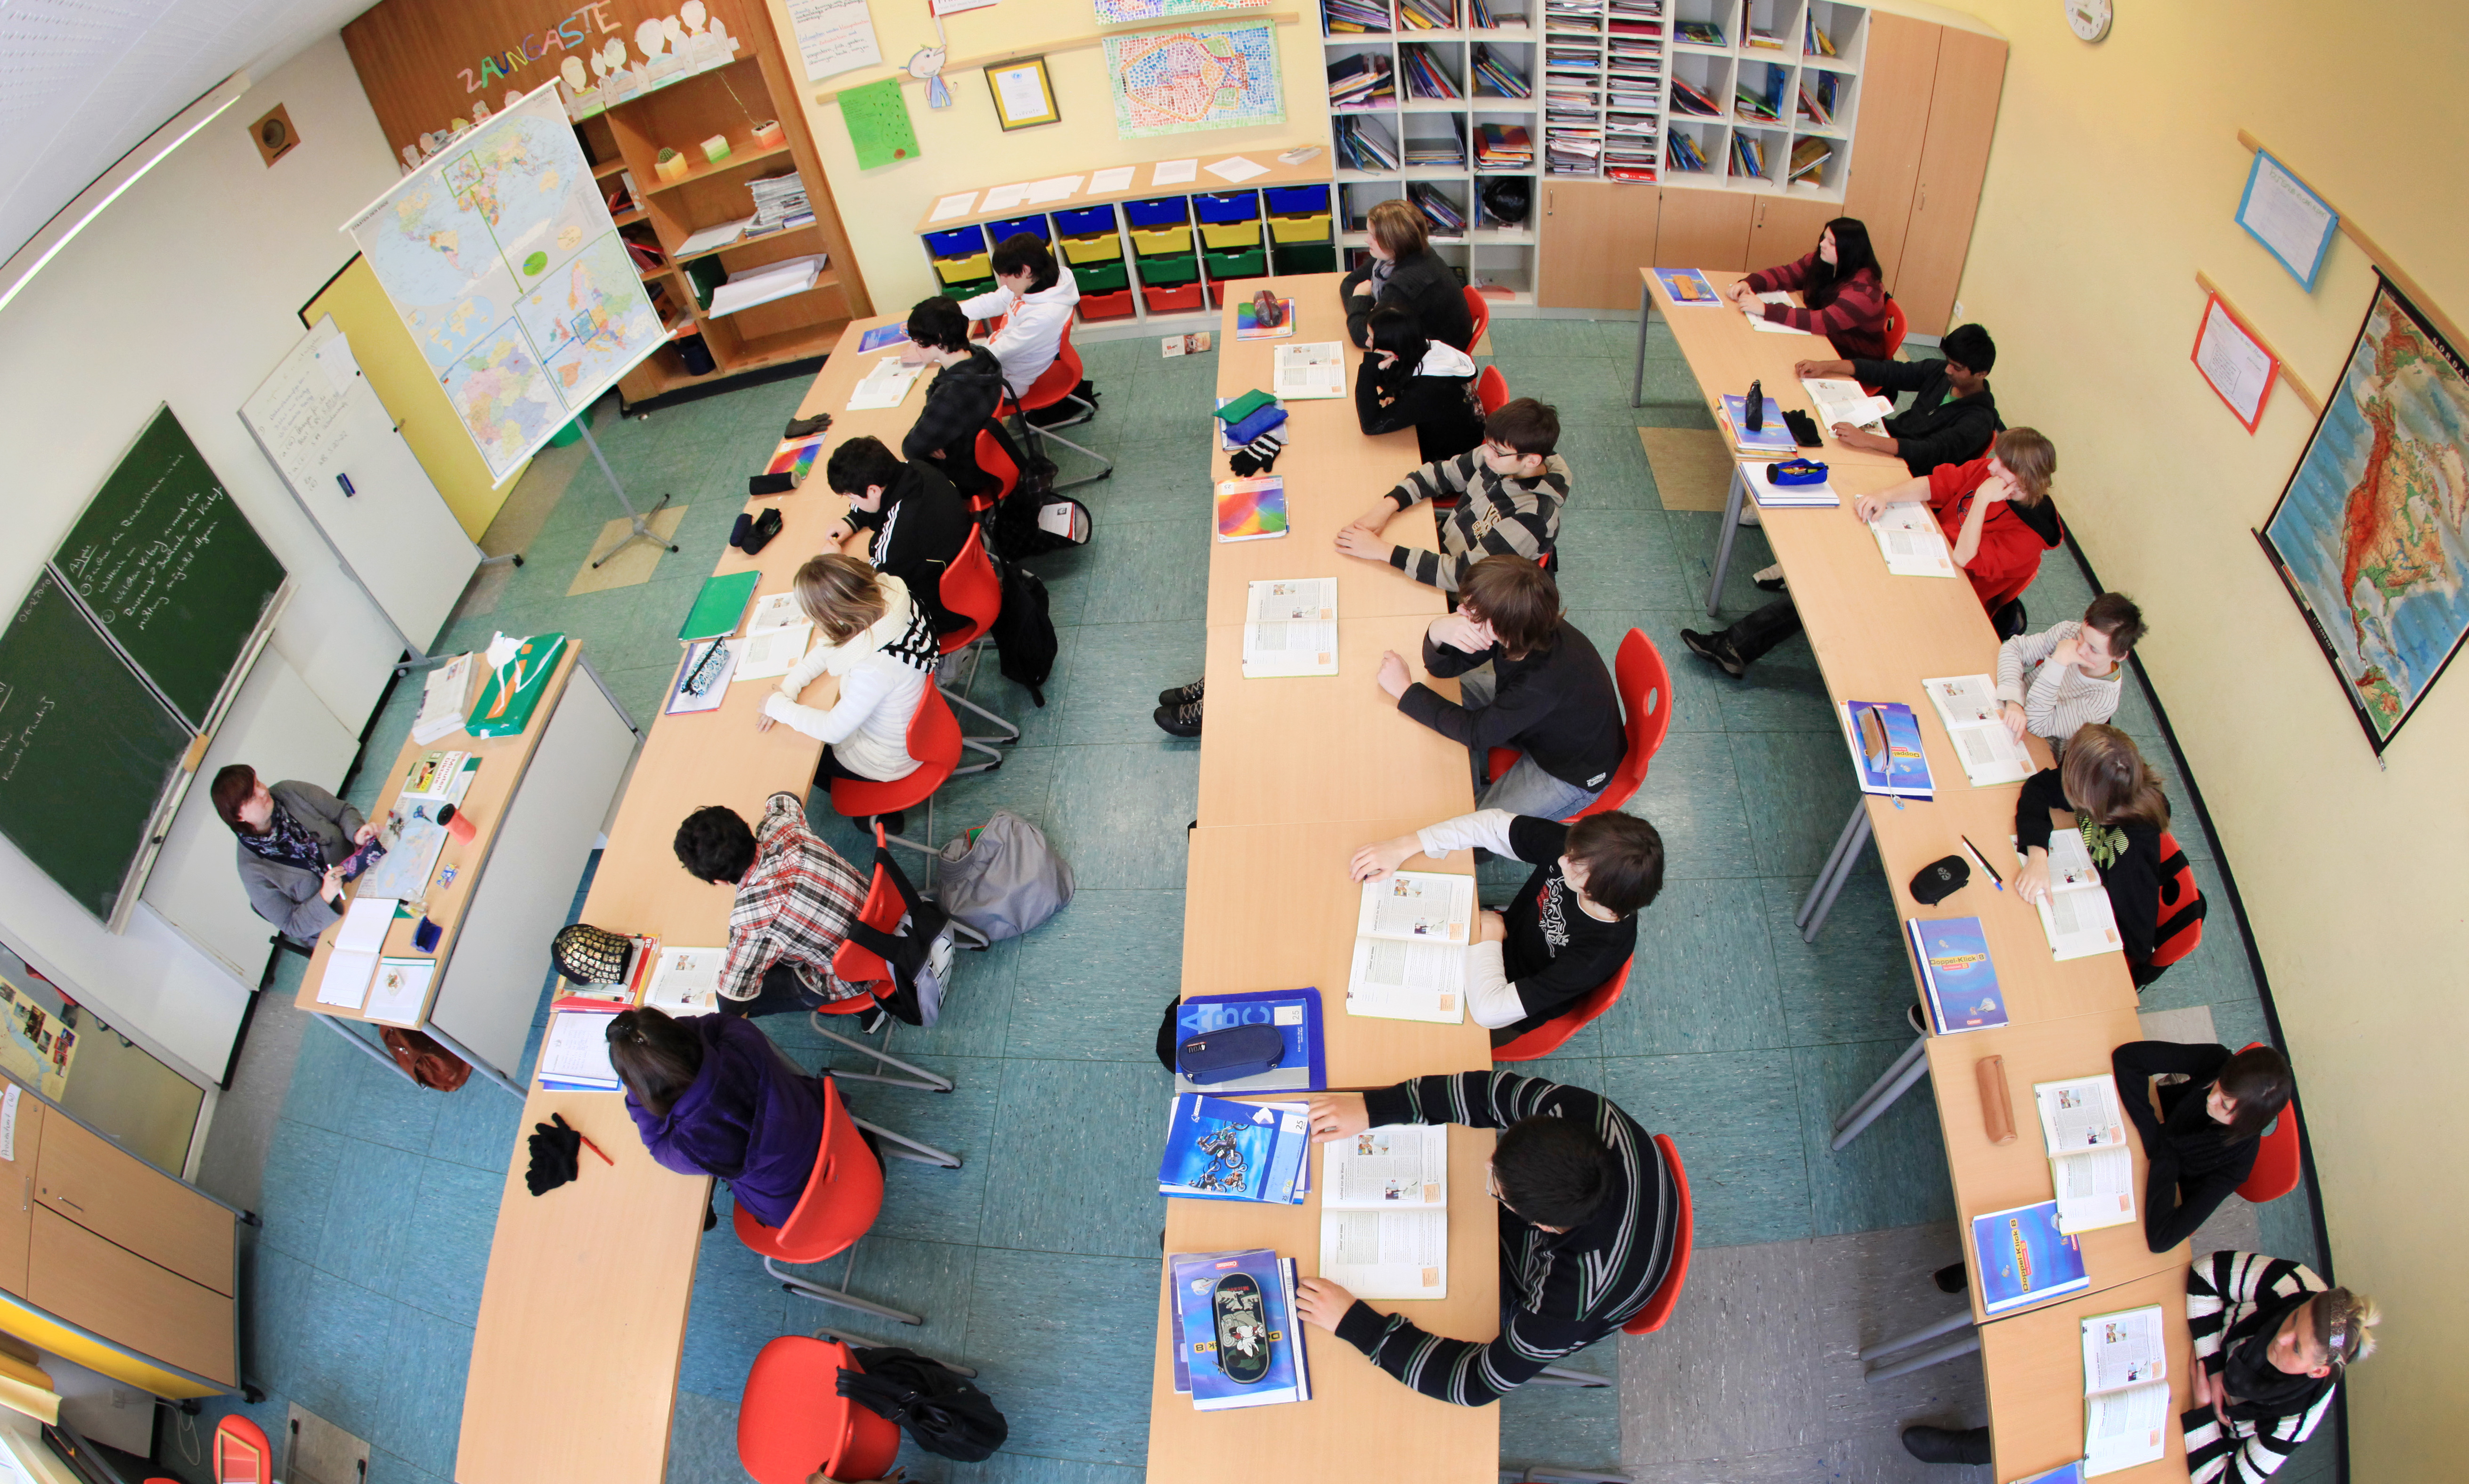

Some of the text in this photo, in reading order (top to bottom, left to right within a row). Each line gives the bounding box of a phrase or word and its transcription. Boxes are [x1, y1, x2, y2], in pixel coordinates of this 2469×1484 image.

[457, 0, 622, 94] ZAUNGÄSTE
[351, 215, 369, 231] STAATEN
[369, 209, 378, 217] DER
[2319, 628, 2327, 639] 000
[2325, 639, 2333, 650] 000
[434, 757, 450, 784] Diktate
[436, 752, 461, 791] 5-Minuten
[644, 937, 652, 948] 28
[1931, 955, 1976, 964] Doppel-Klick
[1292, 1010, 1299, 1019] 25
[1189, 1044, 1205, 1053] 4YOU
[1295, 1119, 1304, 1130] 25
[2013, 1230, 2029, 1290] Doppel-Klick
